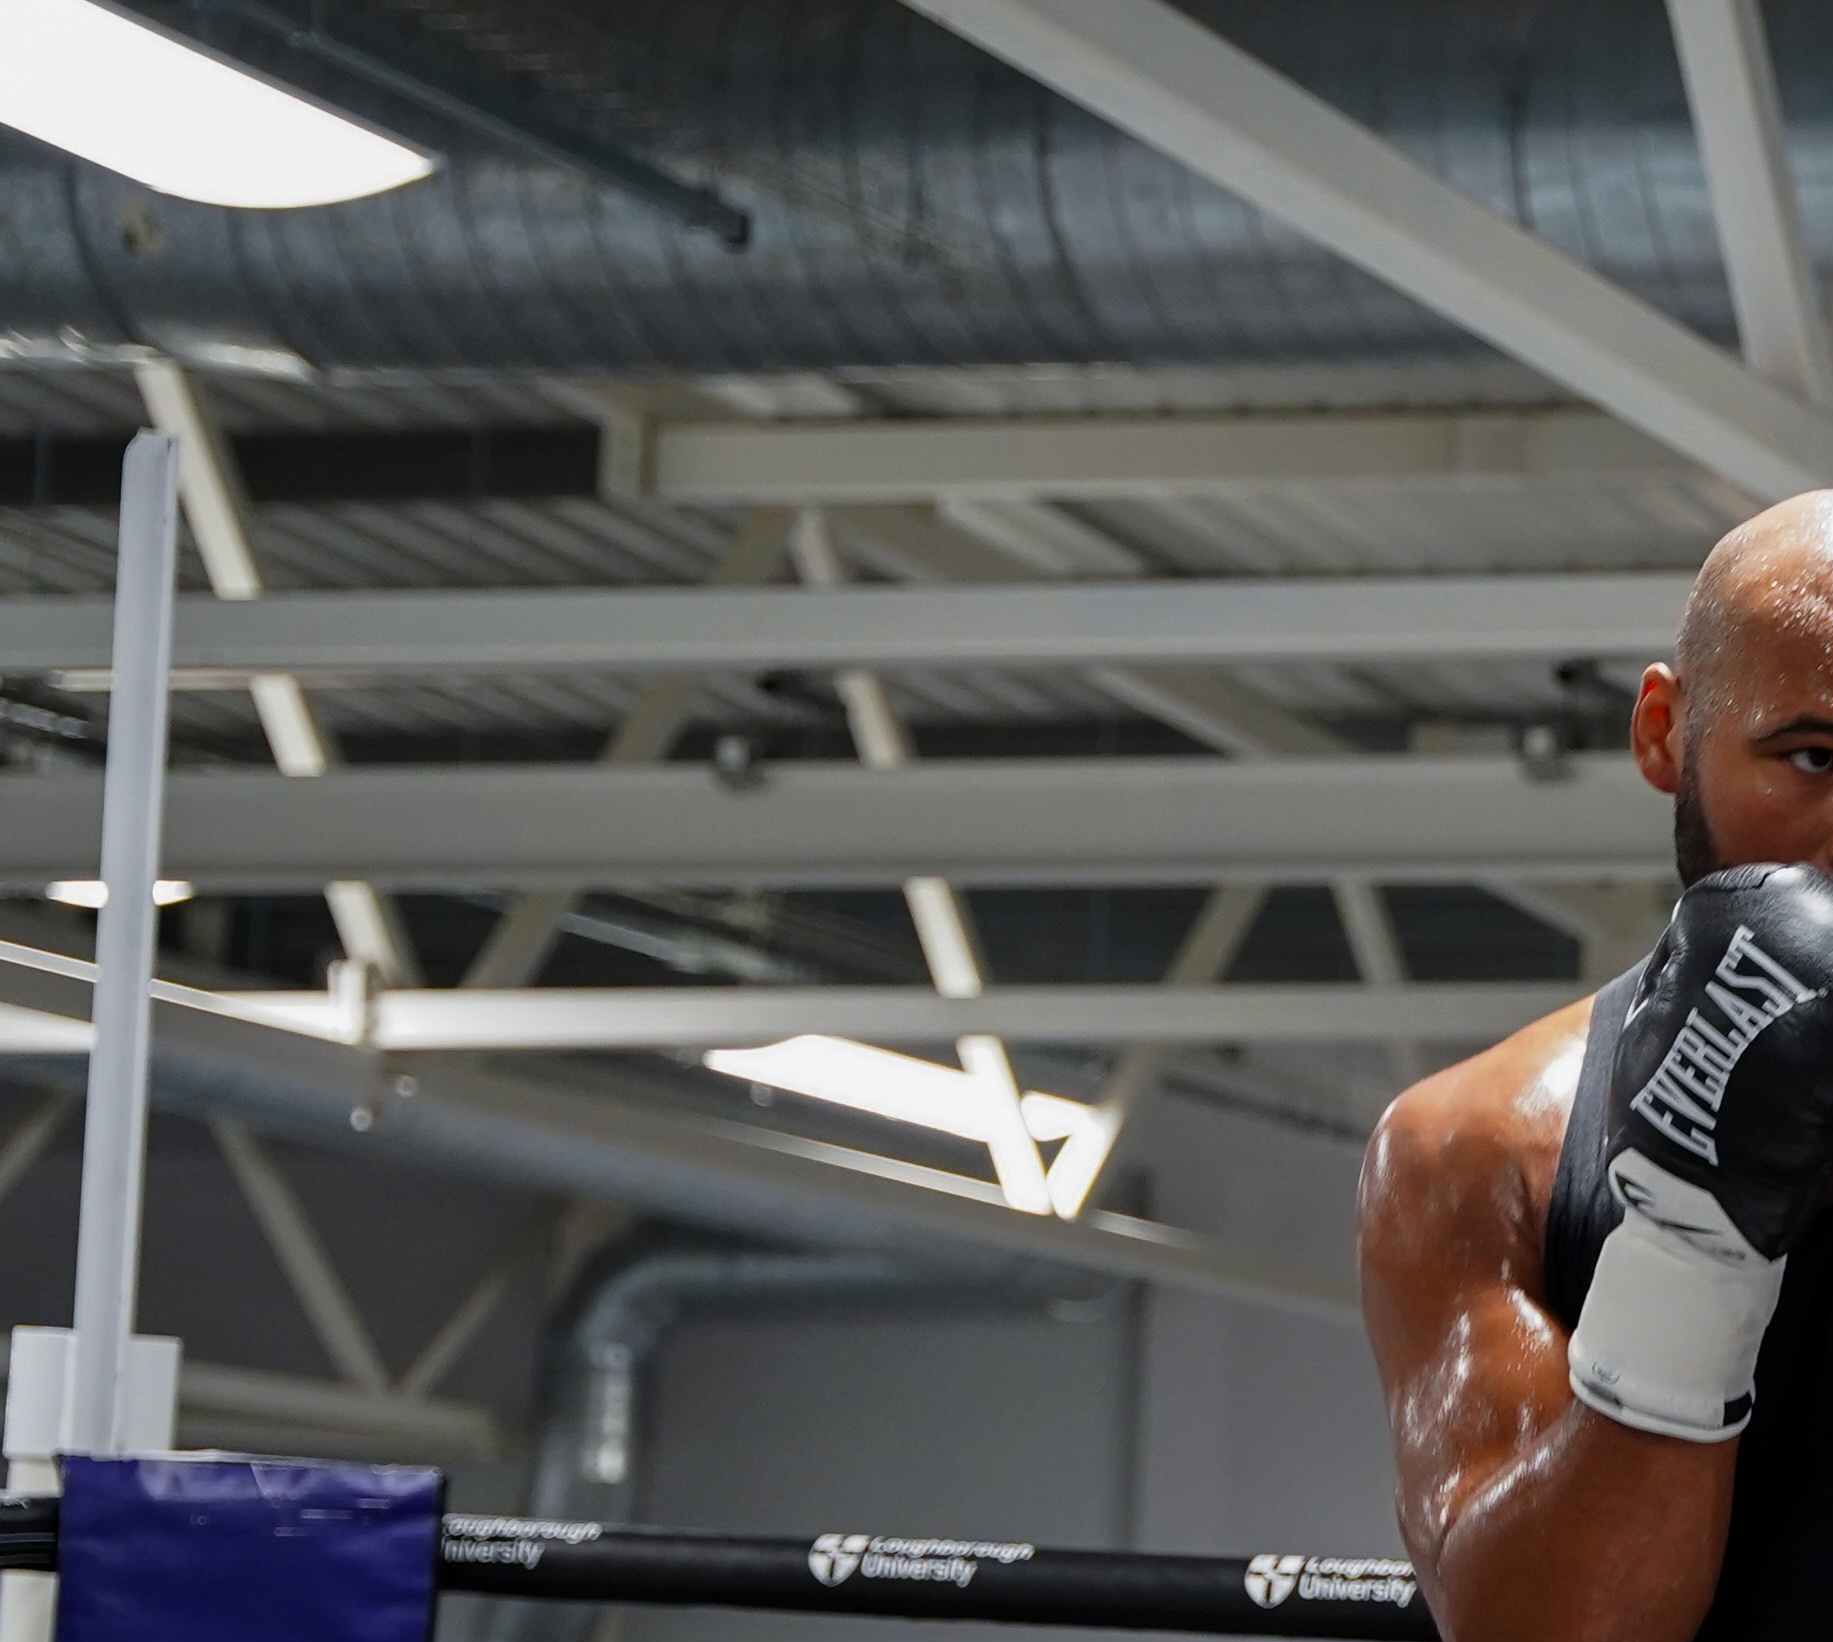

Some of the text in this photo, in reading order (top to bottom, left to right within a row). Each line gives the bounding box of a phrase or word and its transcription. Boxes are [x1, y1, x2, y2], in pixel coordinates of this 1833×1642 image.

[1629, 924, 1818, 1167] EVERLAST
[443, 1536, 546, 1570] niversity
[860, 1553, 978, 1588] University
[1298, 1573, 1418, 1608] University
